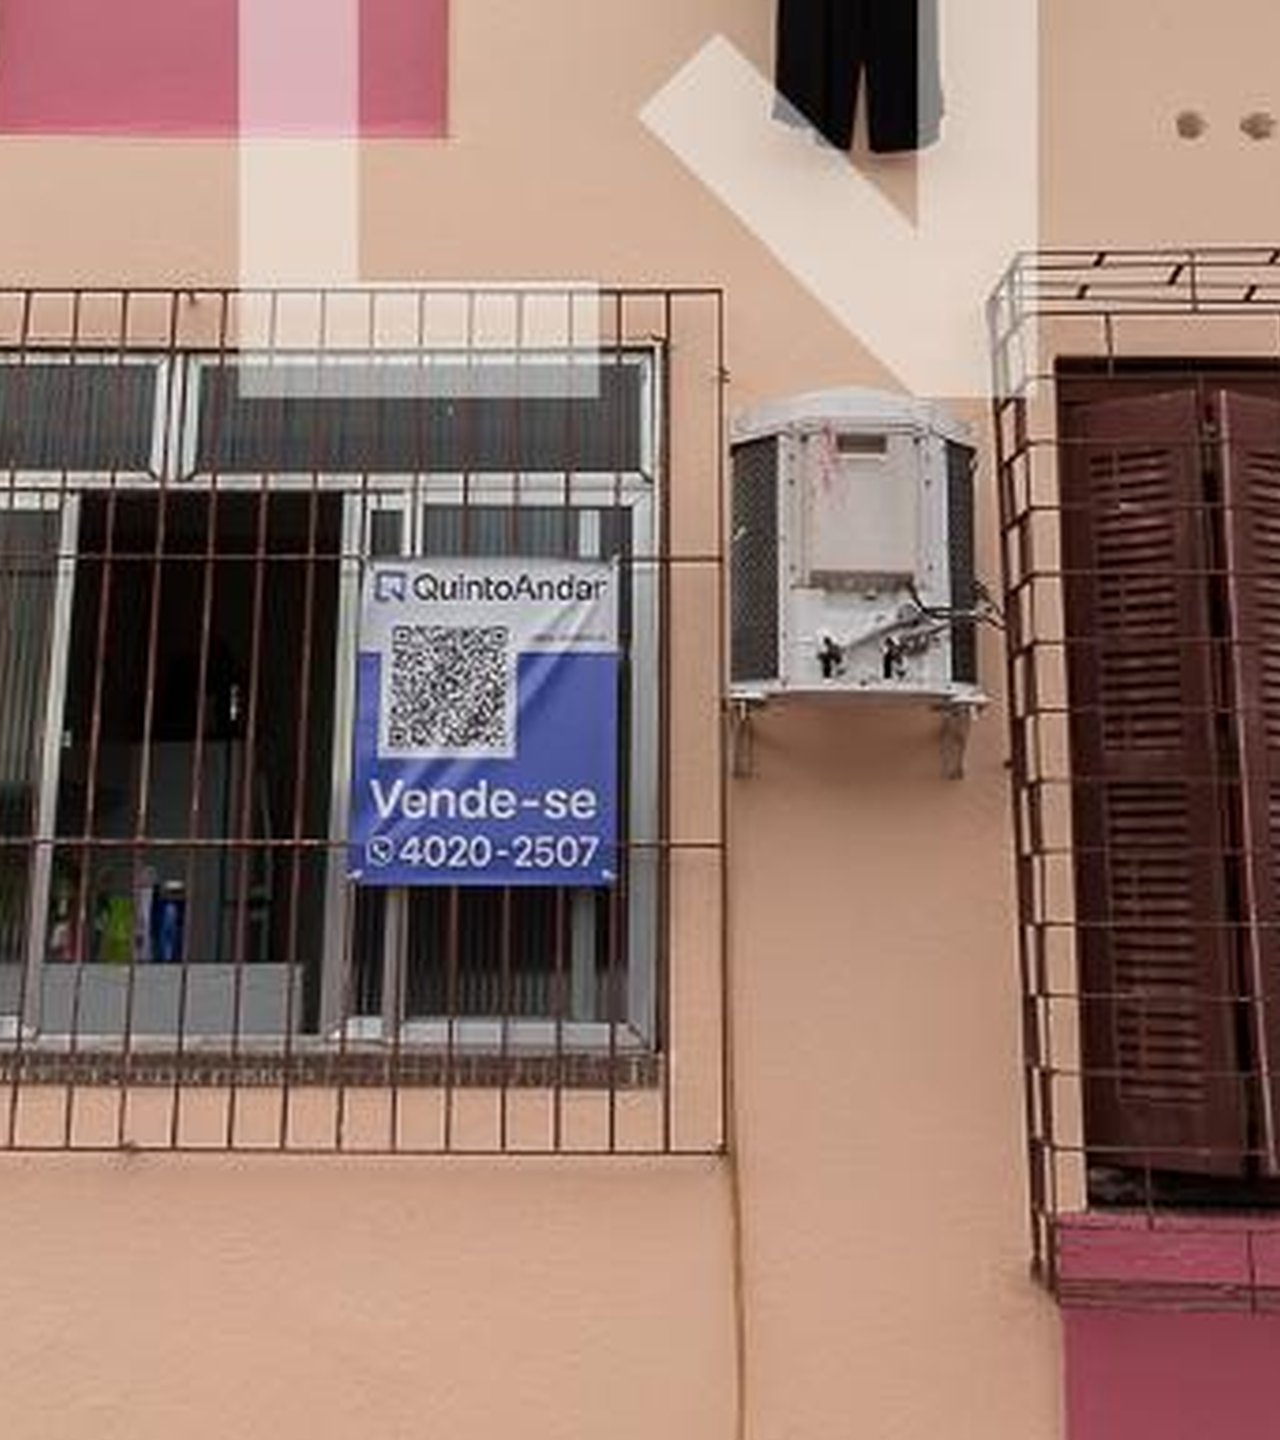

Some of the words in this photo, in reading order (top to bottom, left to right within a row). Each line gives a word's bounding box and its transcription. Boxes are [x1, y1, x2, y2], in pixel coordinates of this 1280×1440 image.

[413, 572, 608, 602] QuintoAndar
[370, 779, 597, 819] Vende-se
[399, 834, 600, 868] 4020-2507
